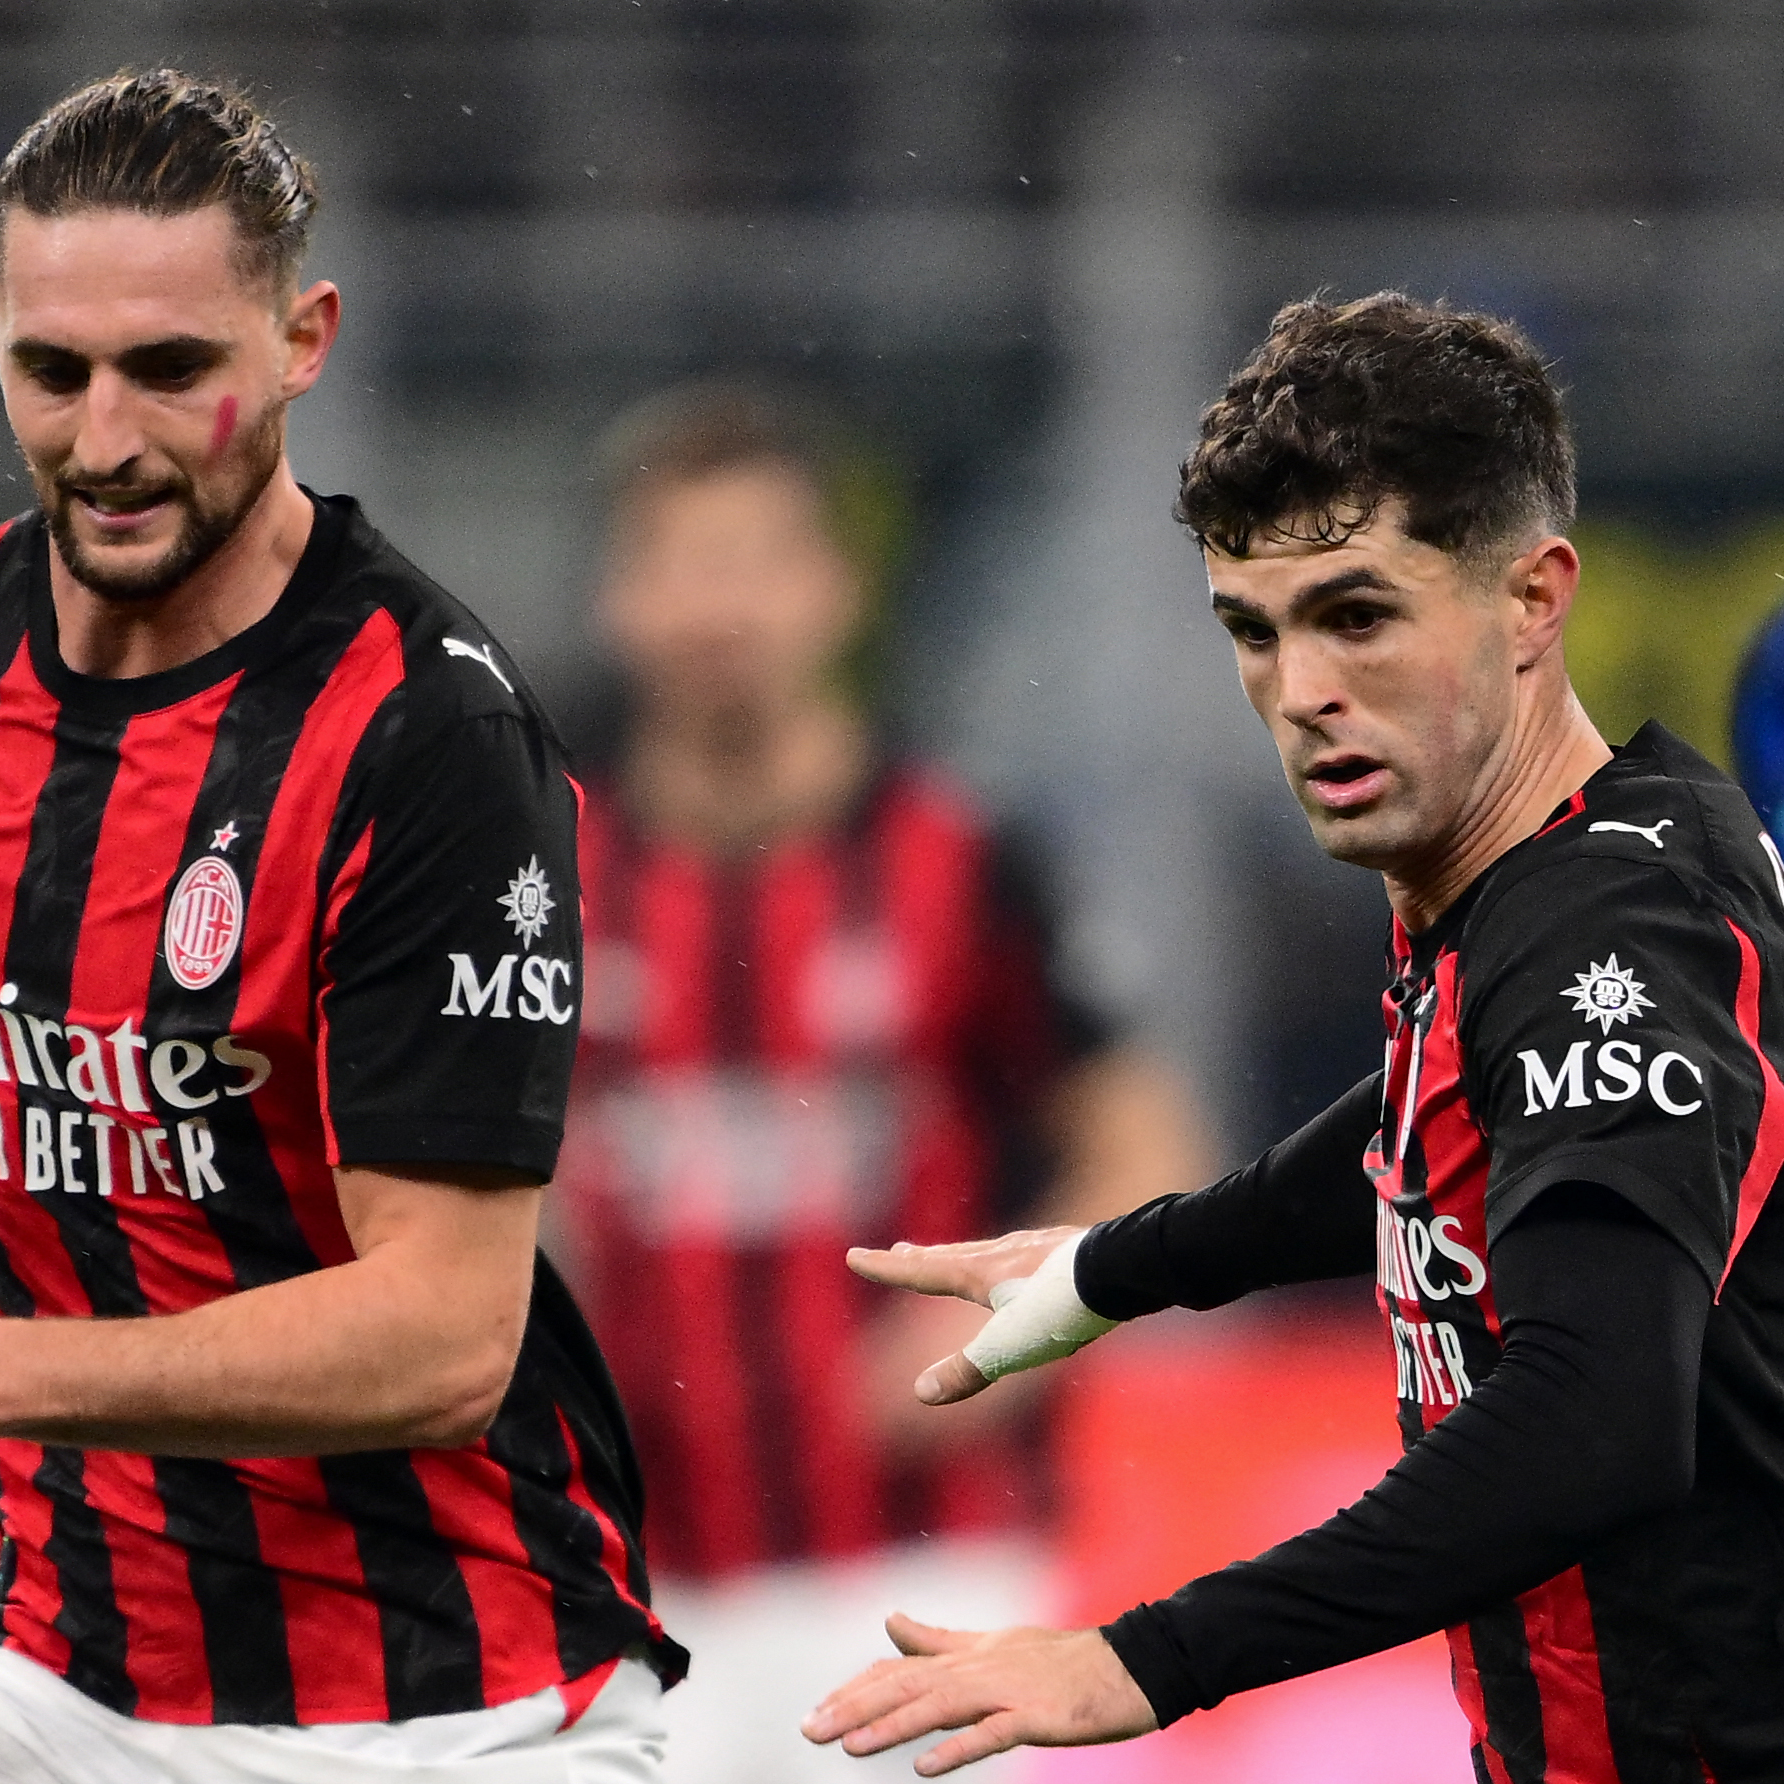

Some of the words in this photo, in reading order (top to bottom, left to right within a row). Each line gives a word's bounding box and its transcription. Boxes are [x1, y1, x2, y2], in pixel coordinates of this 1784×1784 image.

[178, 955, 214, 974] 1899
[441, 953, 574, 1025] MSC
[1516, 1040, 1704, 1117] MSC
[24, 1105, 226, 1201] BETTER
